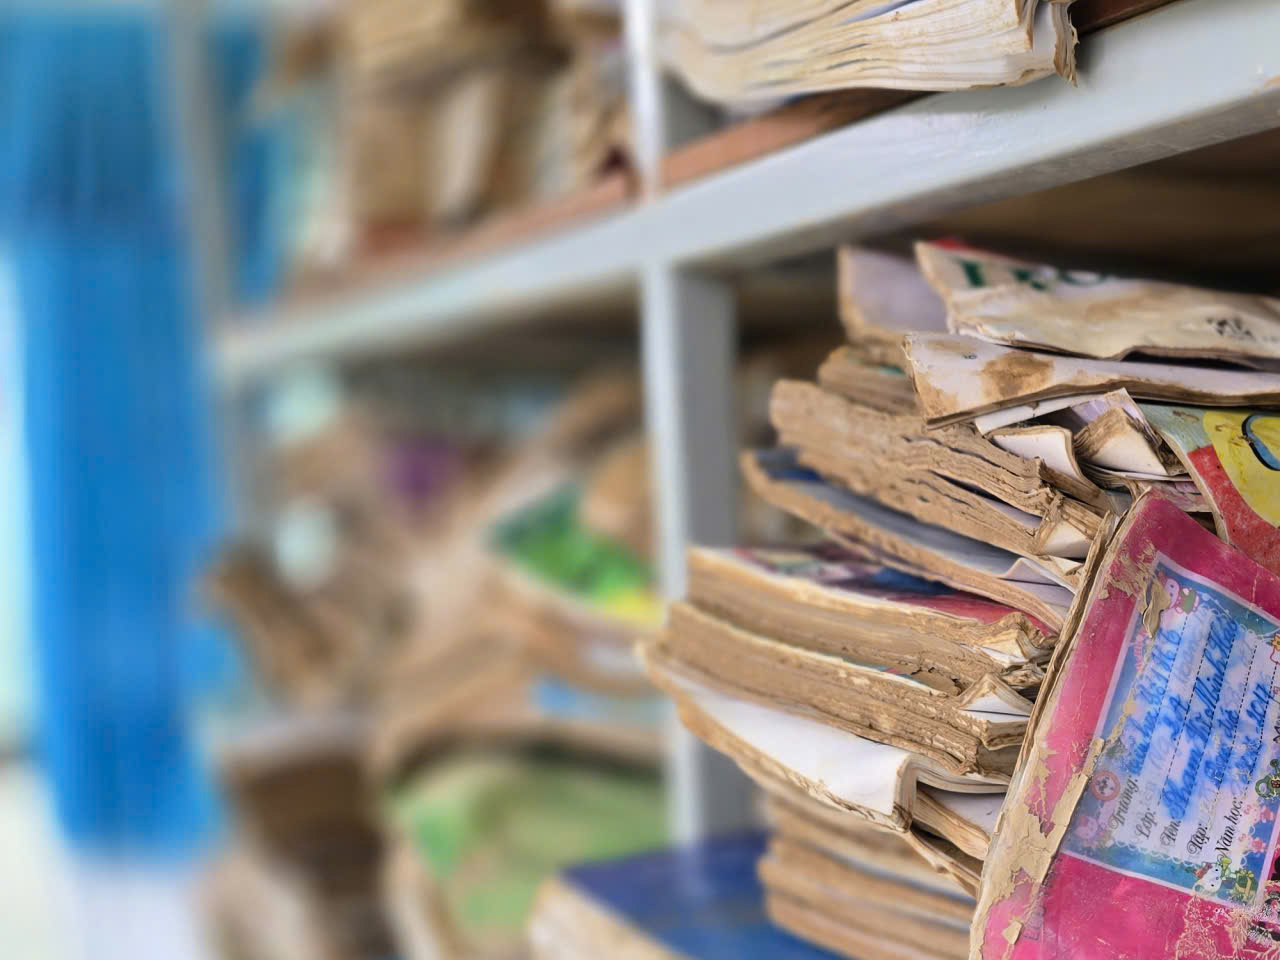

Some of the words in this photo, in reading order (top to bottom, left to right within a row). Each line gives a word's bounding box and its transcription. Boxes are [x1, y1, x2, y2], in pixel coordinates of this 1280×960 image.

[1134, 807, 1160, 842] Lớp:
[1160, 818, 1181, 847] Tên:
[1186, 823, 1208, 856] Tập:
[1215, 823, 1235, 858] Năm
[1225, 797, 1243, 824] học:
